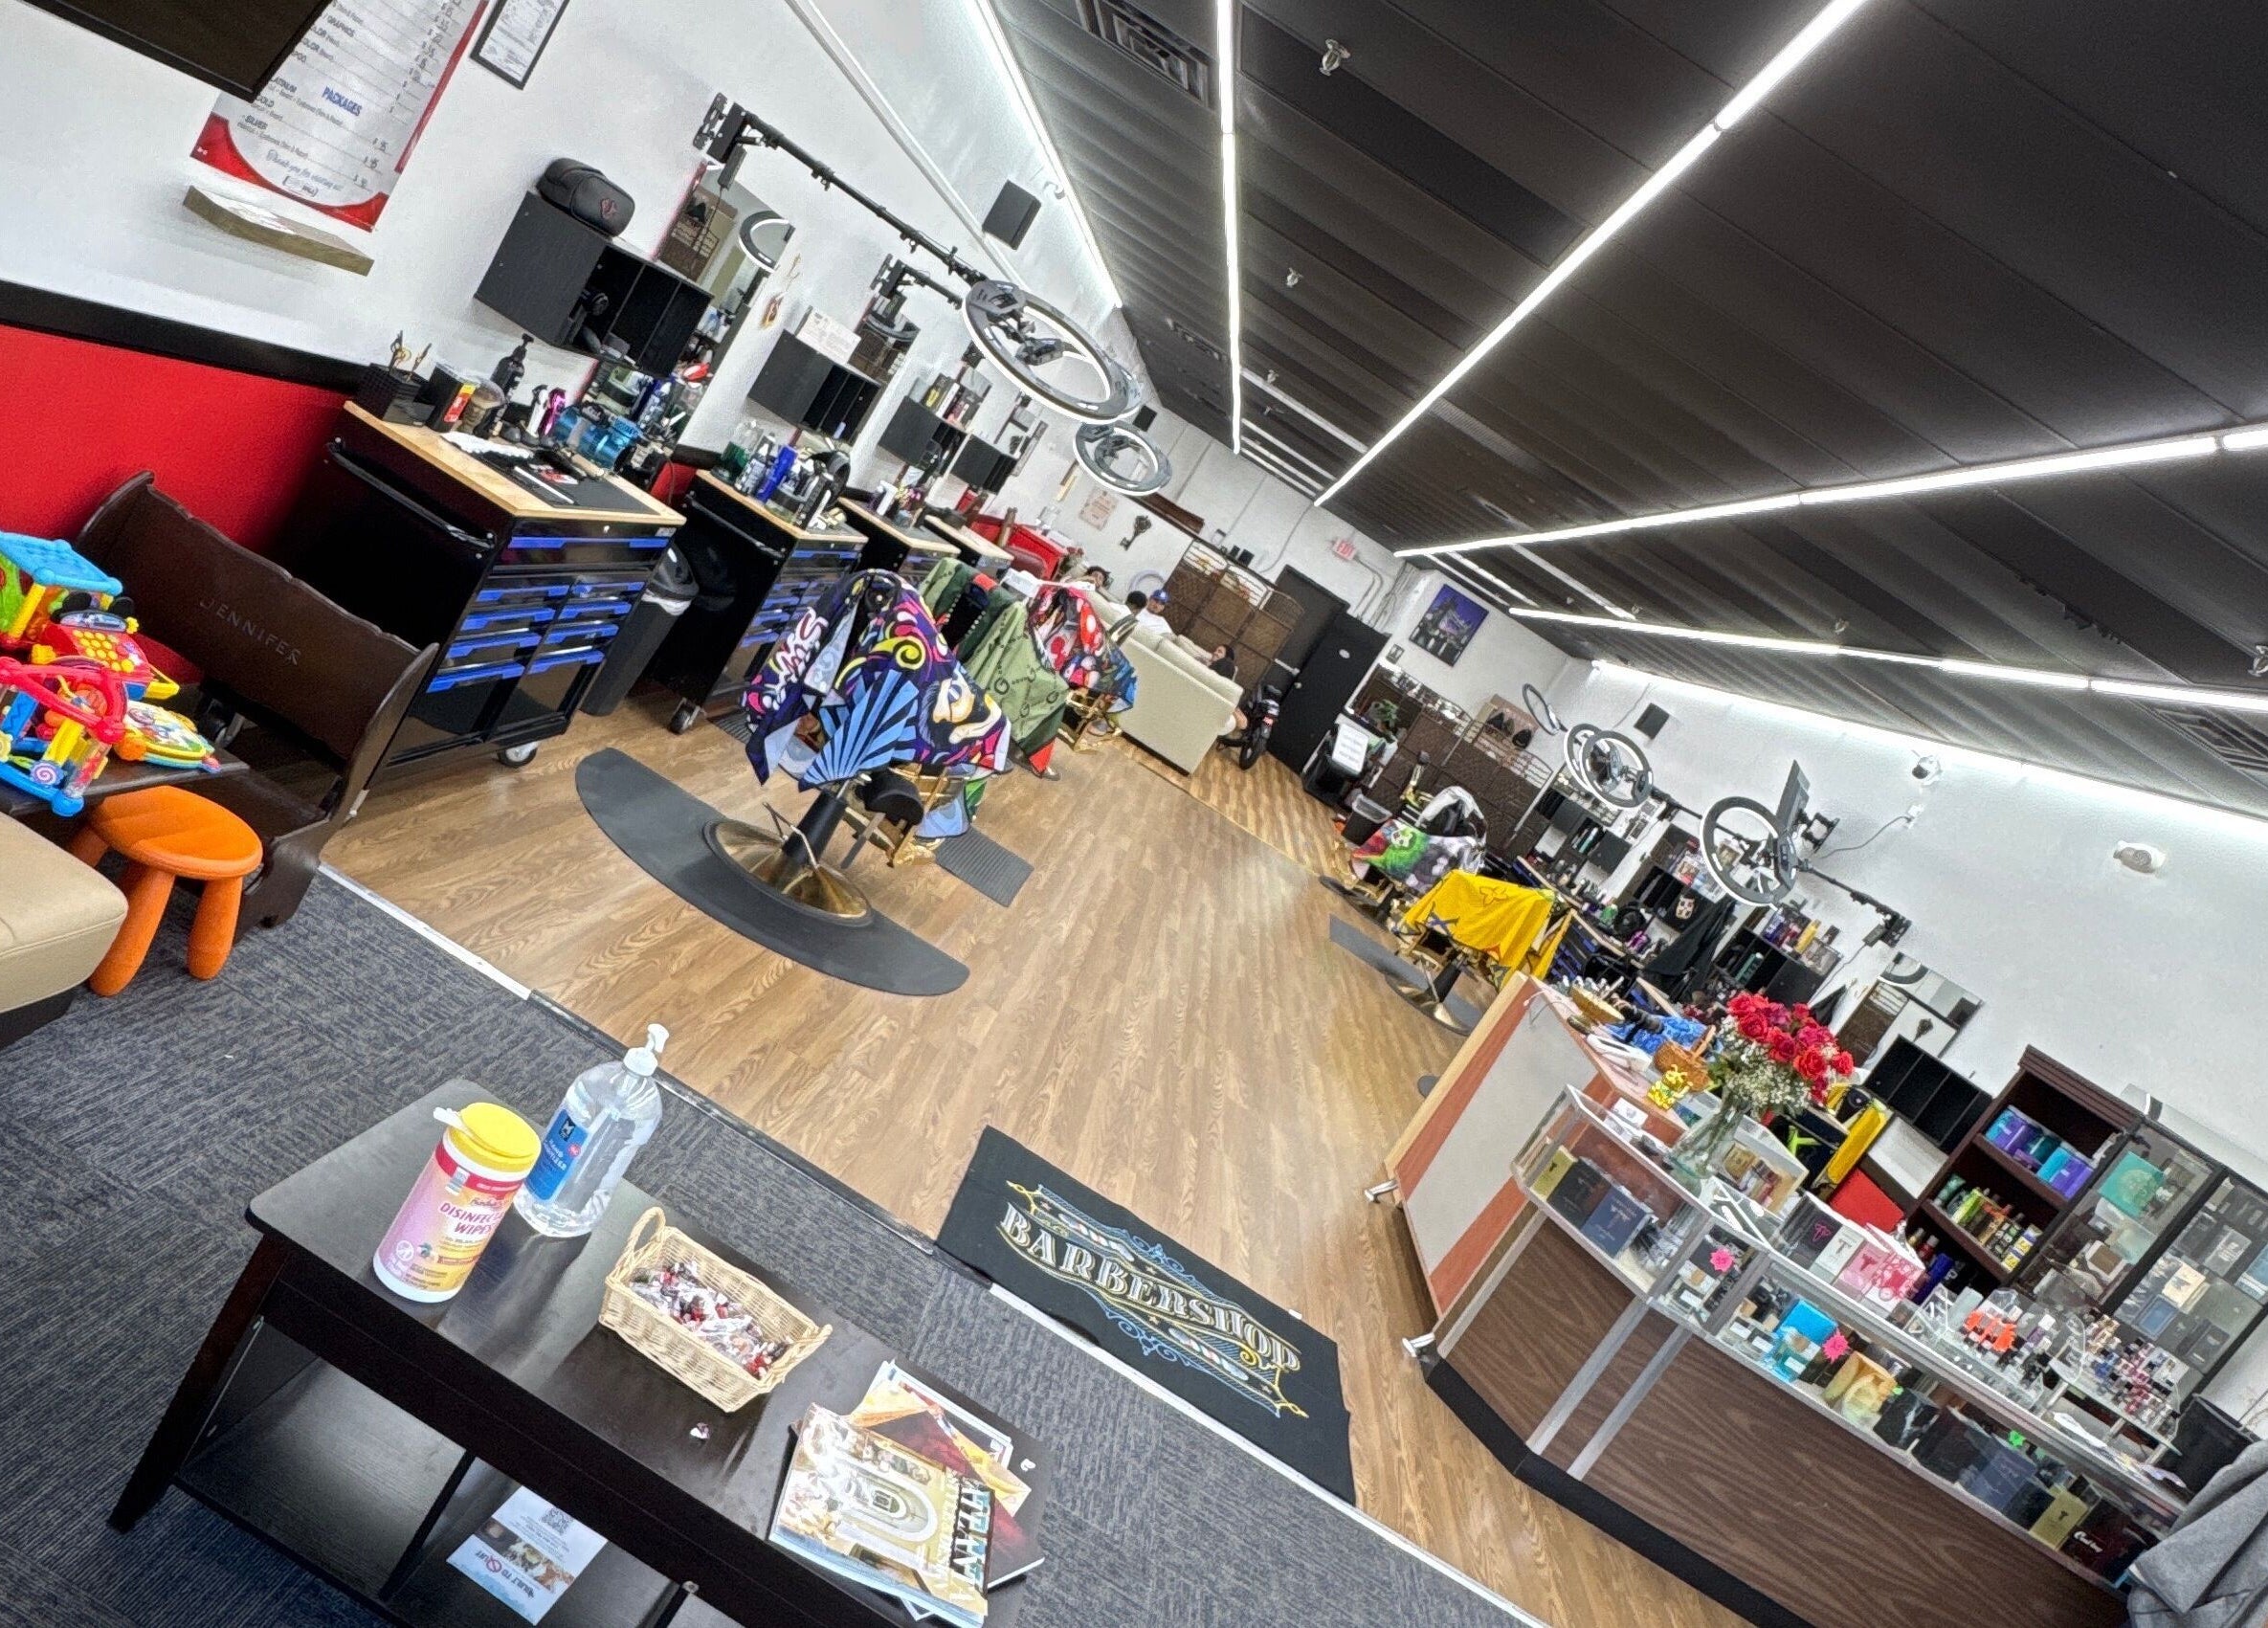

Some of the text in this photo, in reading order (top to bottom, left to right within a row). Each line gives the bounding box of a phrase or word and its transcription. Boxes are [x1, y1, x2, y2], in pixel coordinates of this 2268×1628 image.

[322, 85, 363, 117] PACKAGES
[199, 598, 302, 666] JENNIFER
[999, 1201, 1301, 1372] BARBERSHOP
